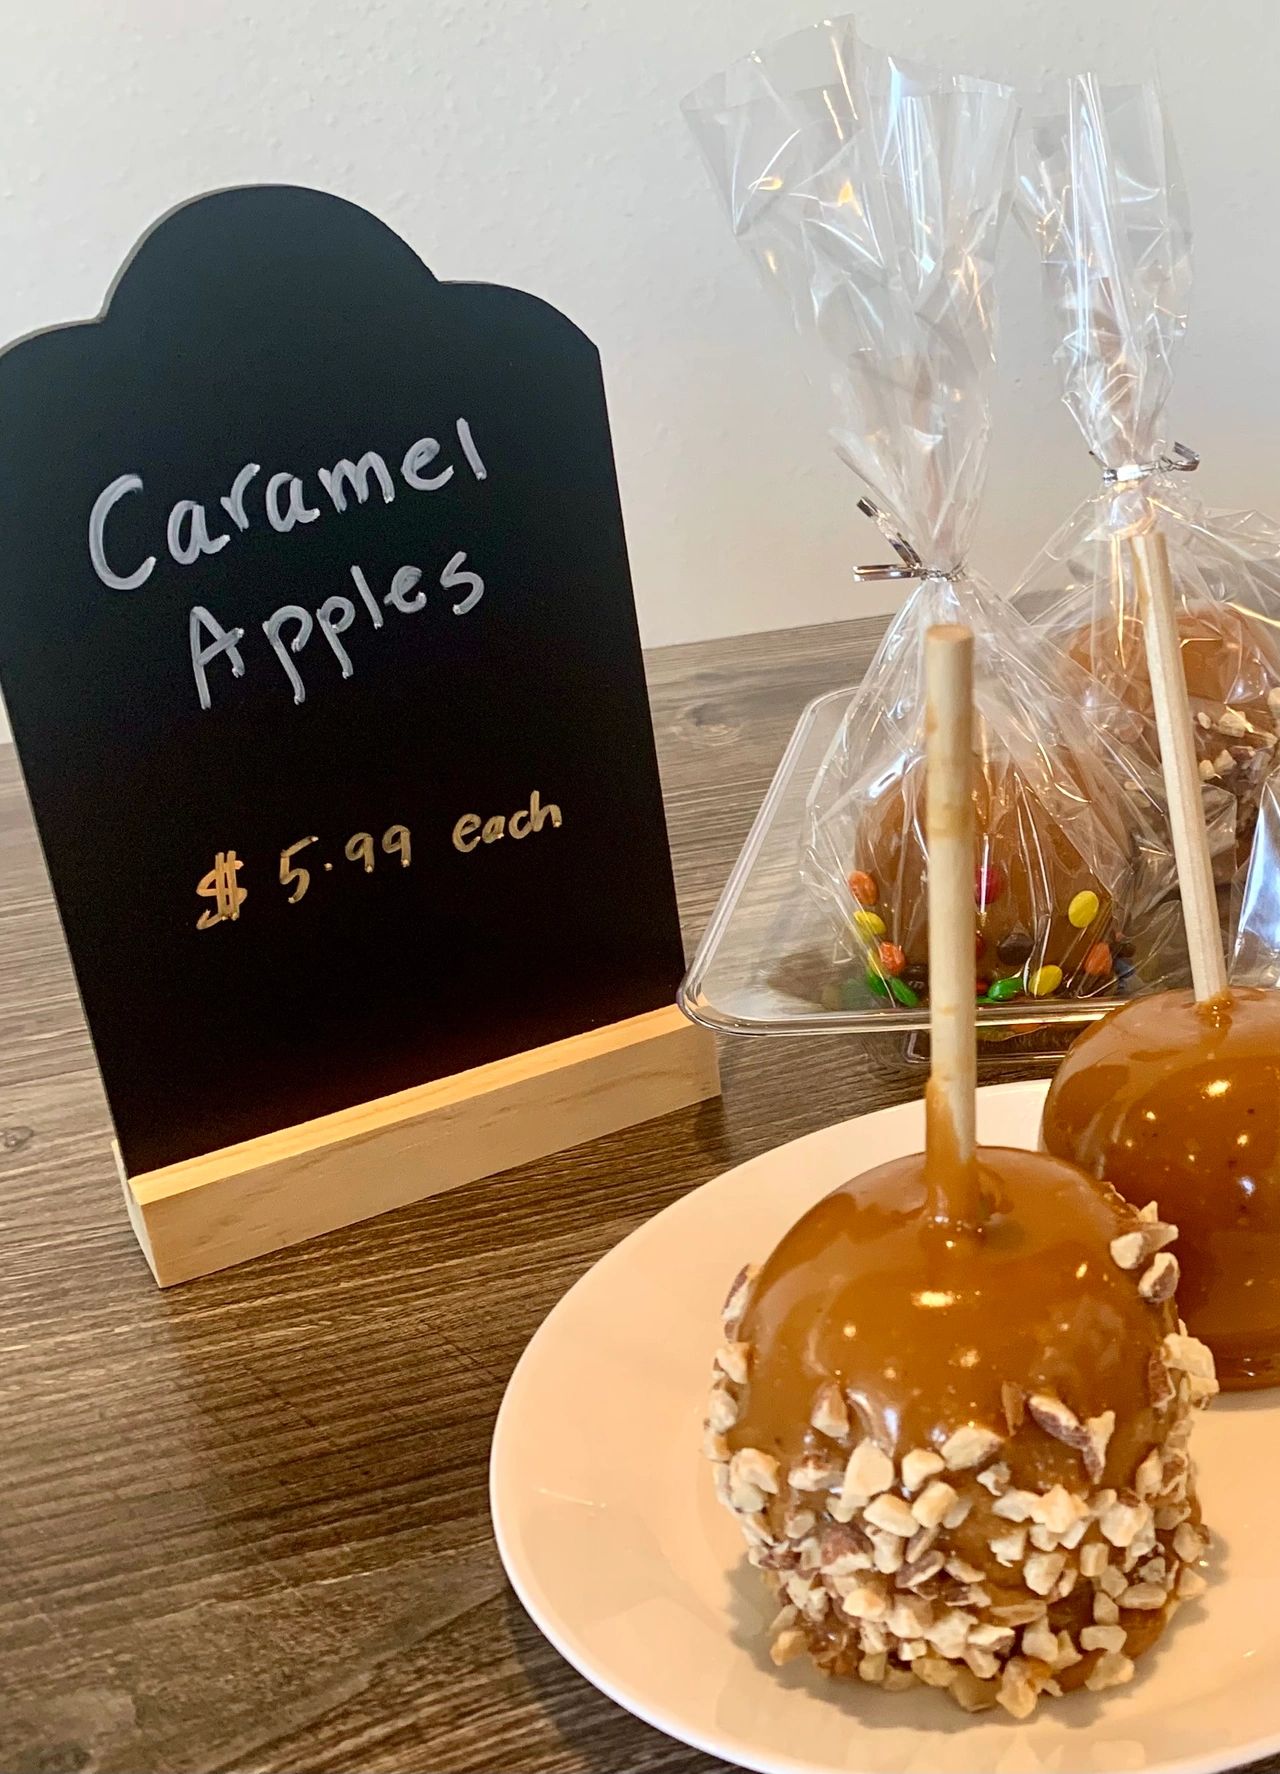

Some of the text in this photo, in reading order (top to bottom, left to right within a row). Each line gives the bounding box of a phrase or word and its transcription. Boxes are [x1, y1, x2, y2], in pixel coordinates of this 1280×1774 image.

[88, 417, 488, 591] Caramel
[189, 550, 485, 710] Apples
[451, 789, 563, 853] each
